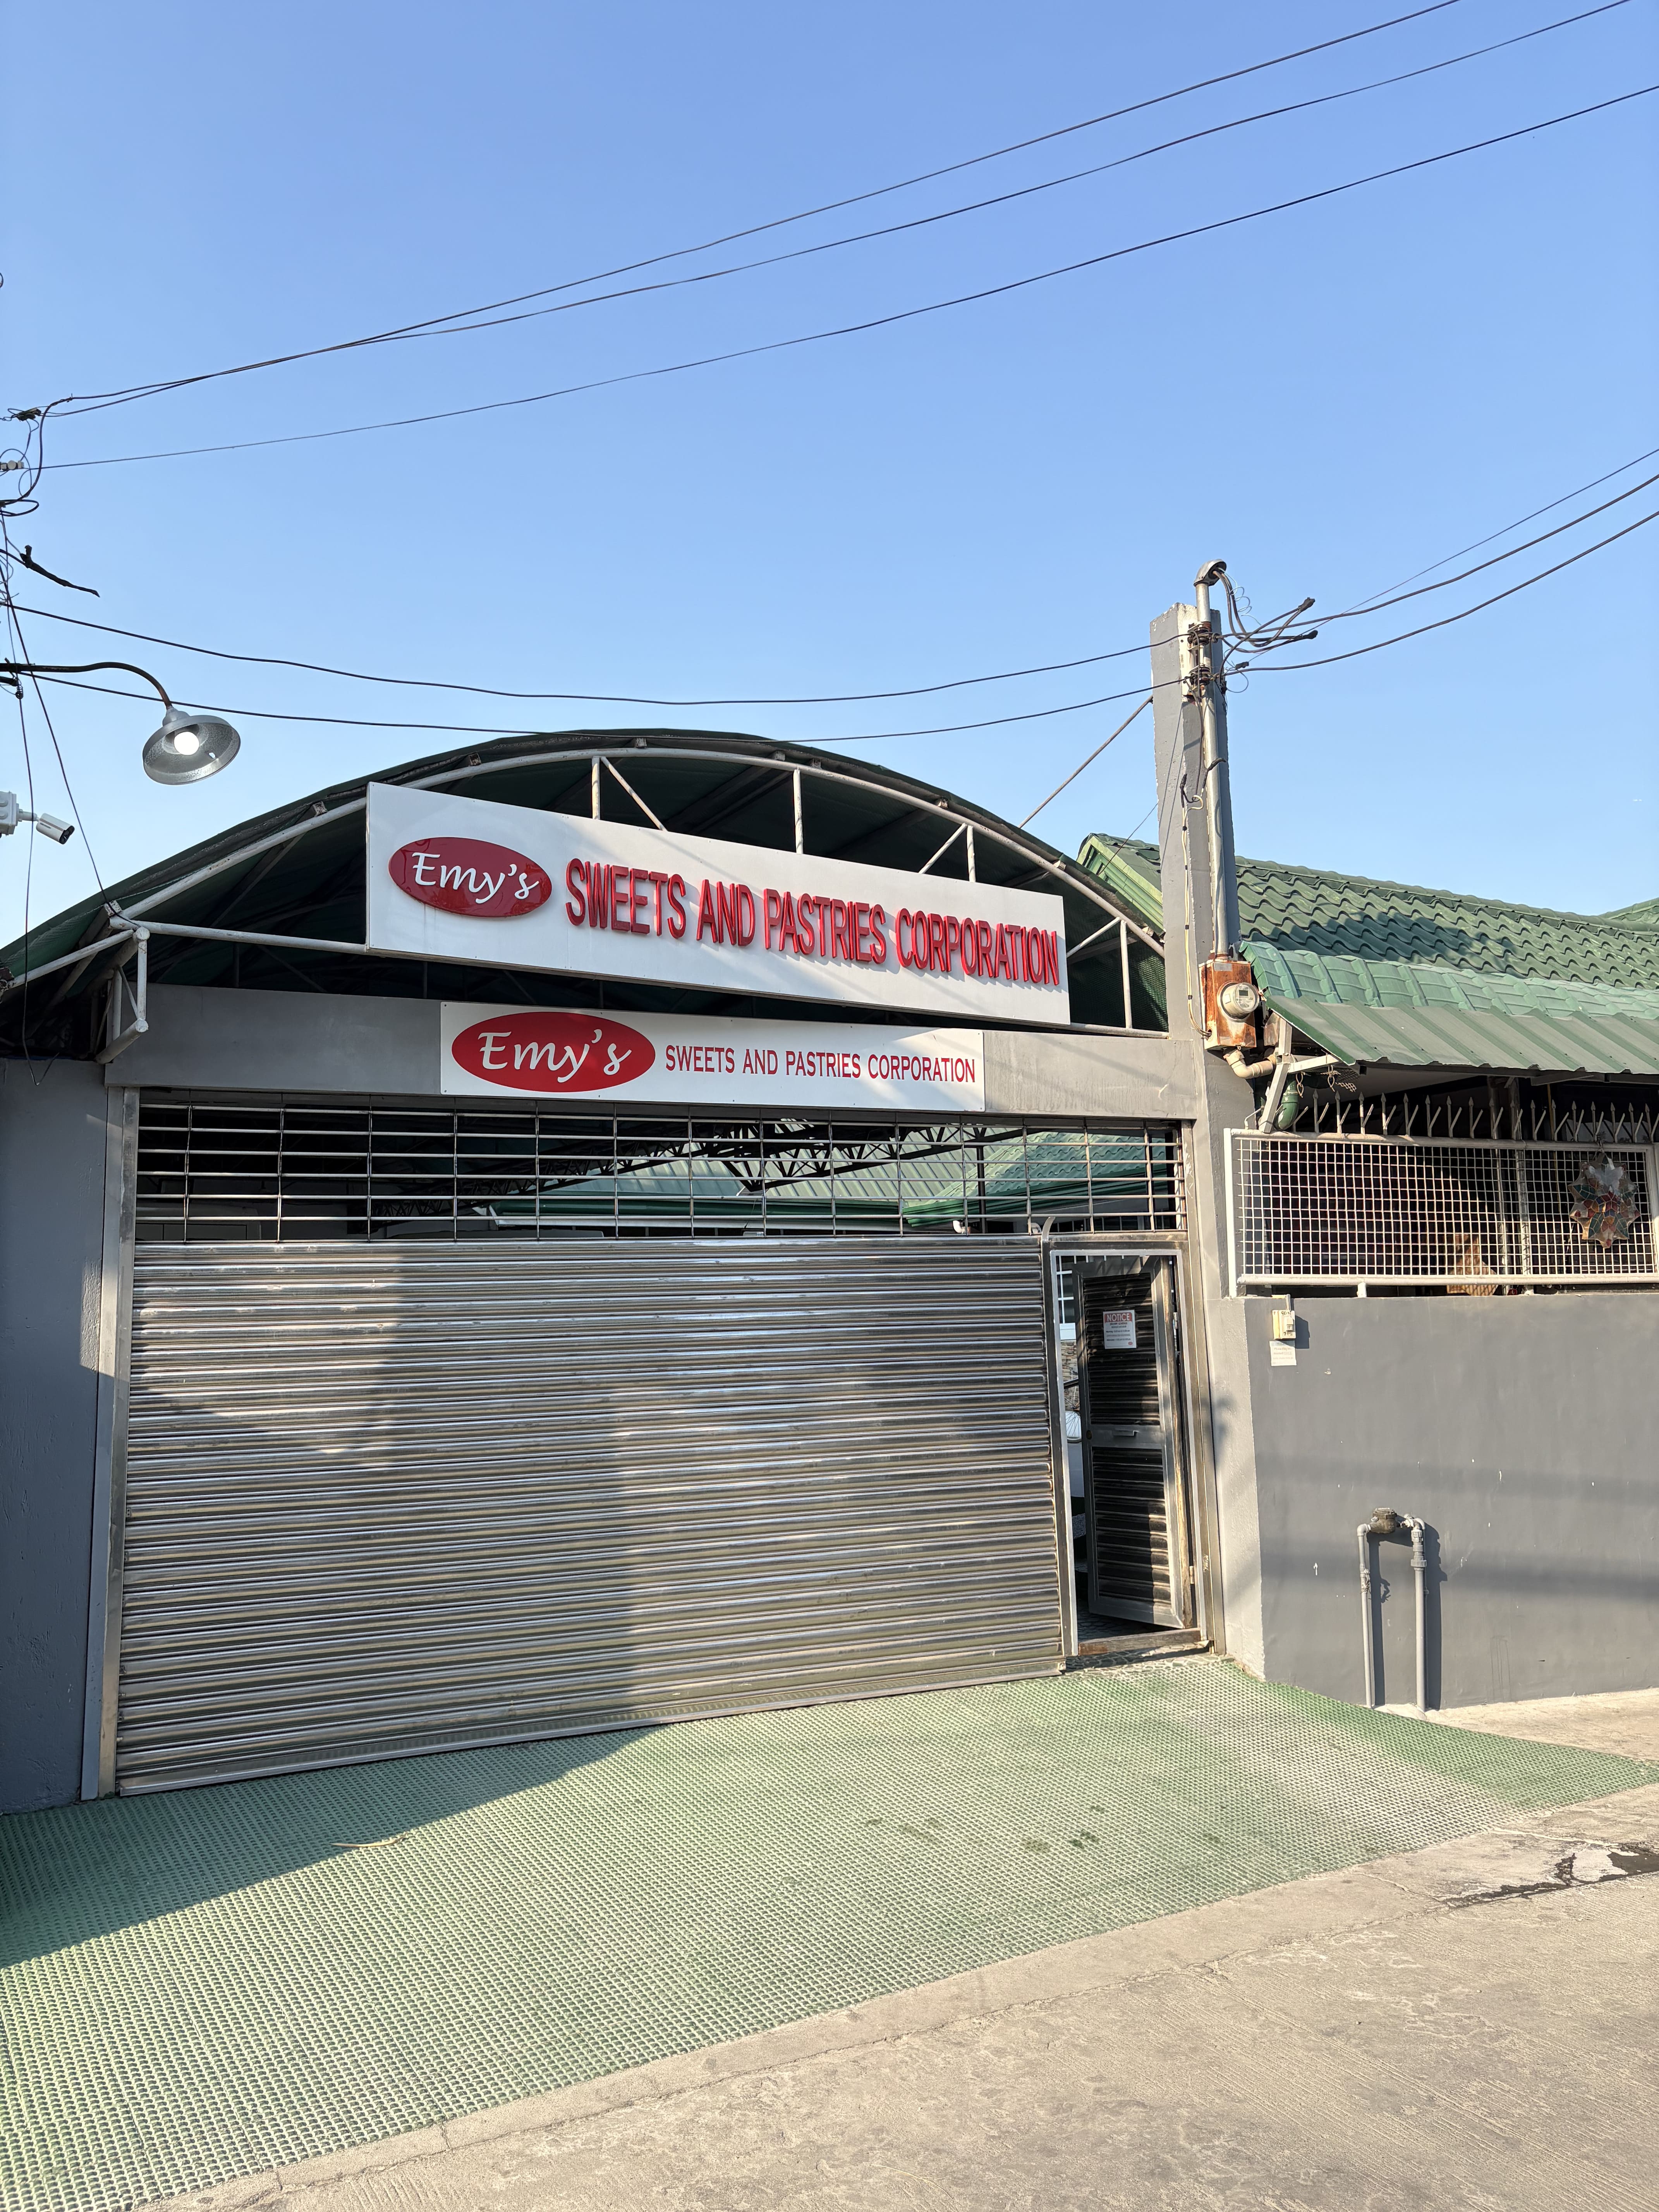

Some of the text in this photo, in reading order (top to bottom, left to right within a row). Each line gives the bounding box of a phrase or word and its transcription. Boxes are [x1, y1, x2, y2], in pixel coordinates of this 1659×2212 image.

[412, 852, 1059, 986] Emy's SWEETS AND PASTRIES CORPORATION
[478, 1029, 975, 1083] Emy's SWEETS AND PASTRIES CORPORATION
[1107, 1313, 1130, 1322] NOTICE
